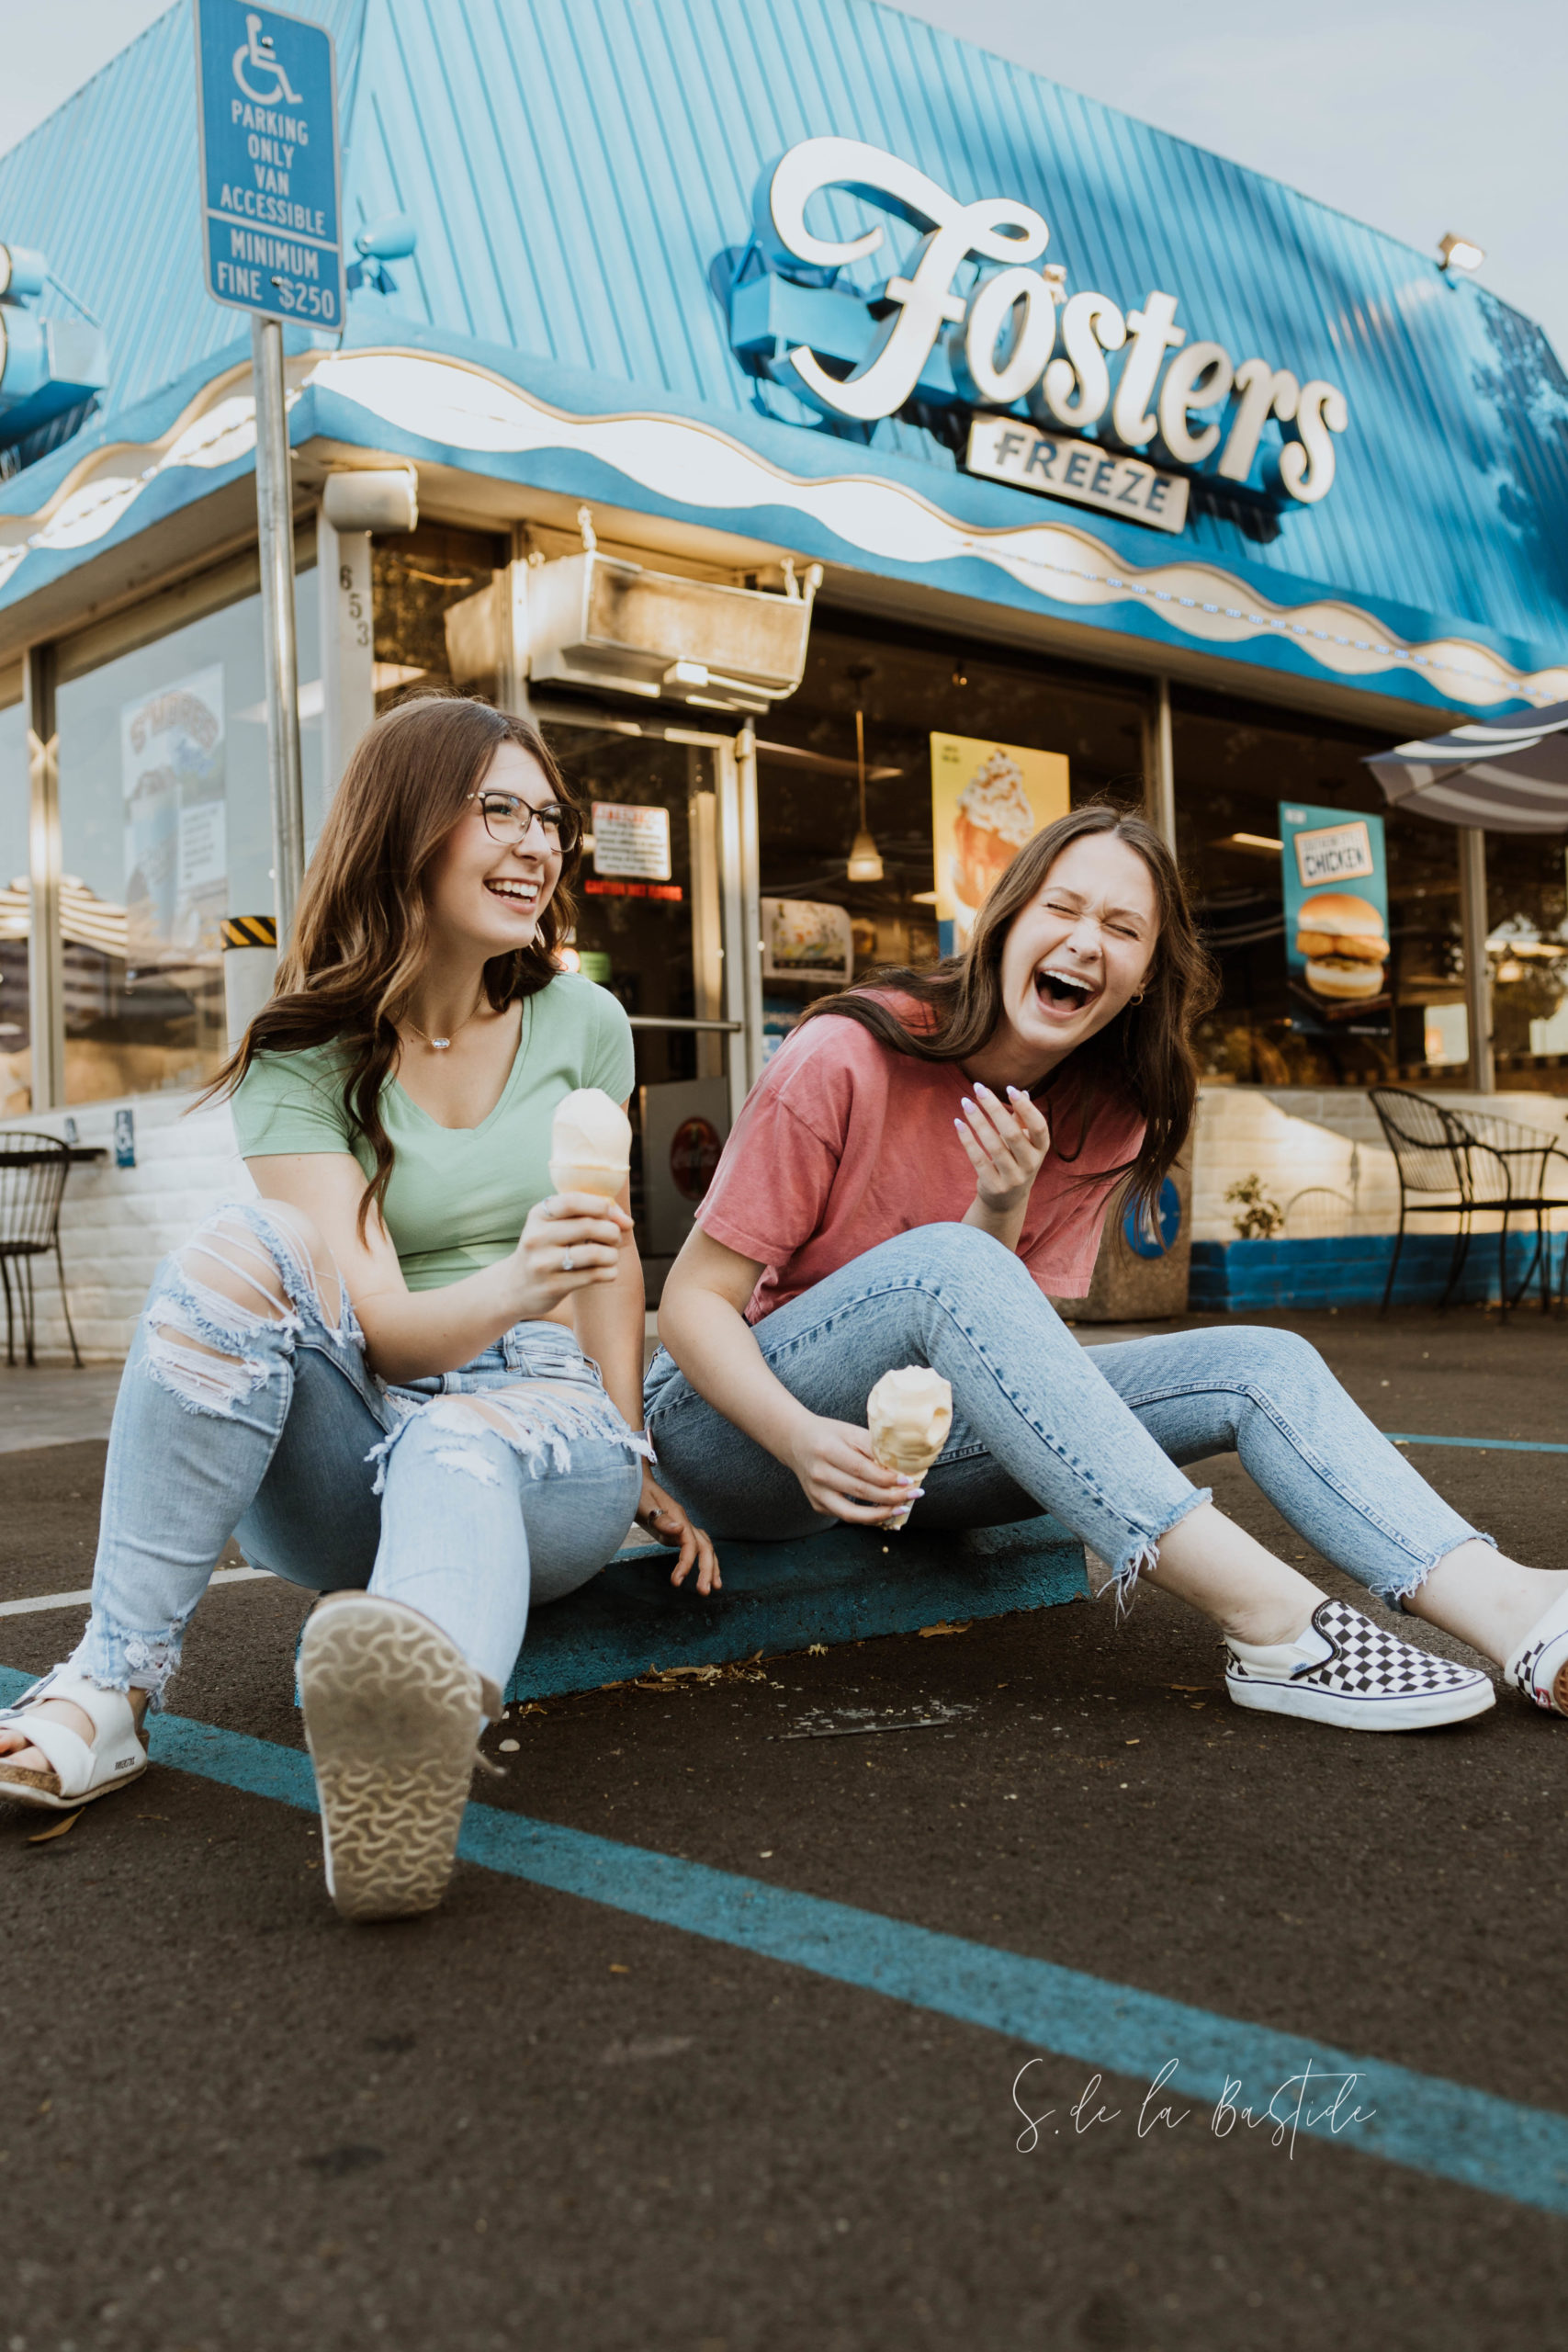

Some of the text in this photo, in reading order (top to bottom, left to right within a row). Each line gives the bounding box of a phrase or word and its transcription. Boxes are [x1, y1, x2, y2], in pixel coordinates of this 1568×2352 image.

[231, 99, 309, 146] PARKING
[247, 133, 295, 170] ONLY
[254, 164, 289, 197] VAN
[220, 184, 326, 236] ACCESSIBLE
[231, 228, 319, 280] MINIMUM
[217, 262, 335, 320] FINE $250
[770, 136, 1348, 503] Fosters
[993, 431, 1172, 514] FREEZE
